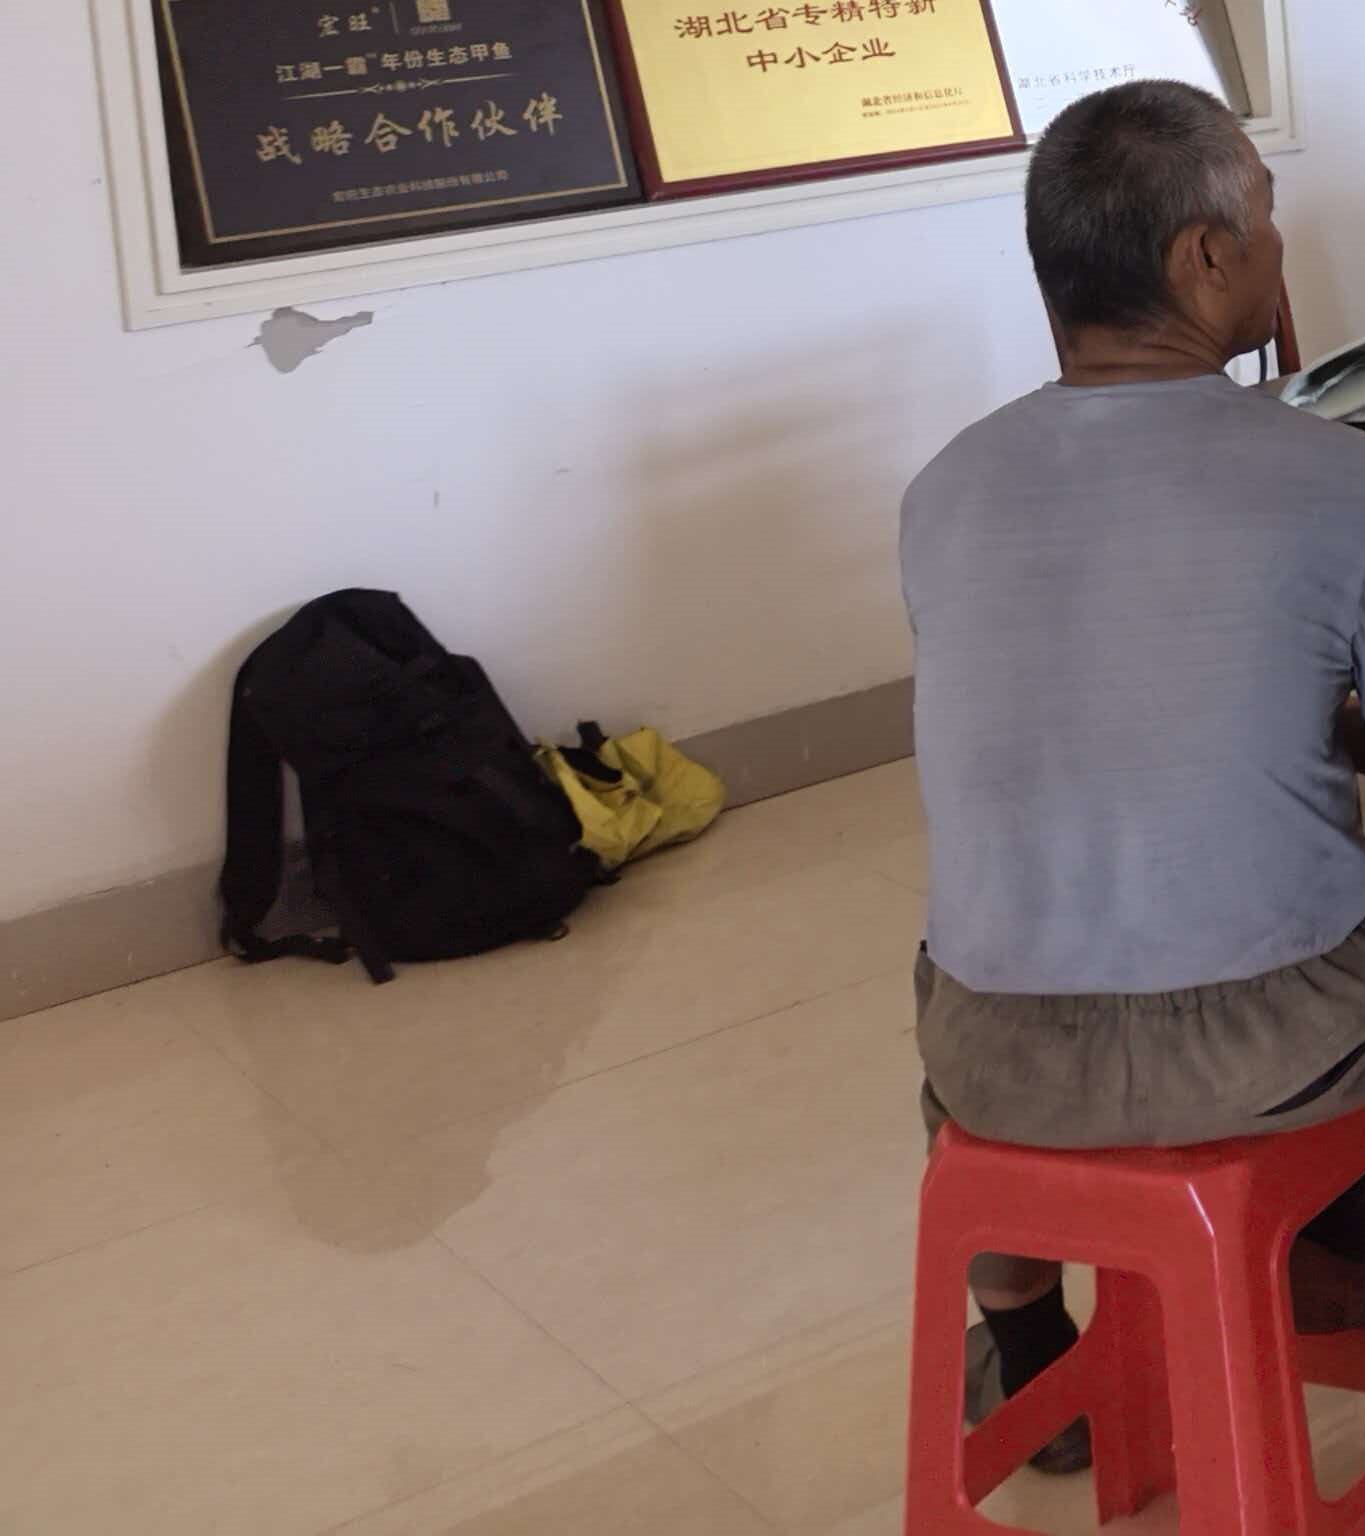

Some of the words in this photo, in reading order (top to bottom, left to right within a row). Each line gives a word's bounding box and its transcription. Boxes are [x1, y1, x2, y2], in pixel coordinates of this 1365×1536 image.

[748, 38, 896, 73] 中小企业
[256, 92, 563, 164] 战略合作伙伴
